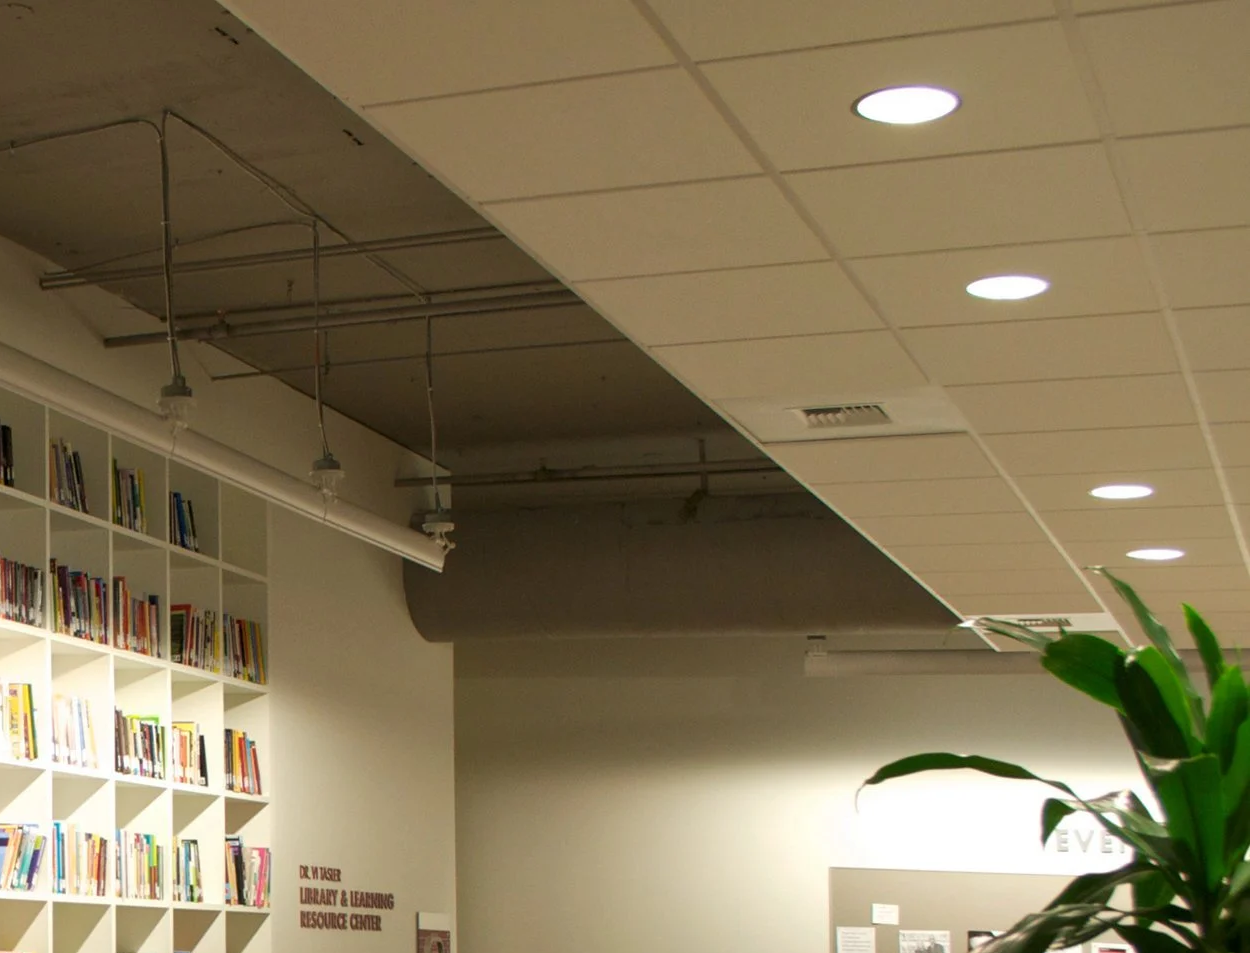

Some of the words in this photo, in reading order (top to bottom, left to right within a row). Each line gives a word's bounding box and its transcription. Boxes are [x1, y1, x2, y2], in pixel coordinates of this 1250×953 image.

[299, 865, 310, 880] DR.
[300, 887, 338, 906] LIBRARY
[340, 889, 348, 908] &
[350, 890, 394, 909] LEARNING
[300, 911, 347, 930] RESOURCE
[350, 913, 381, 931] CENTER
